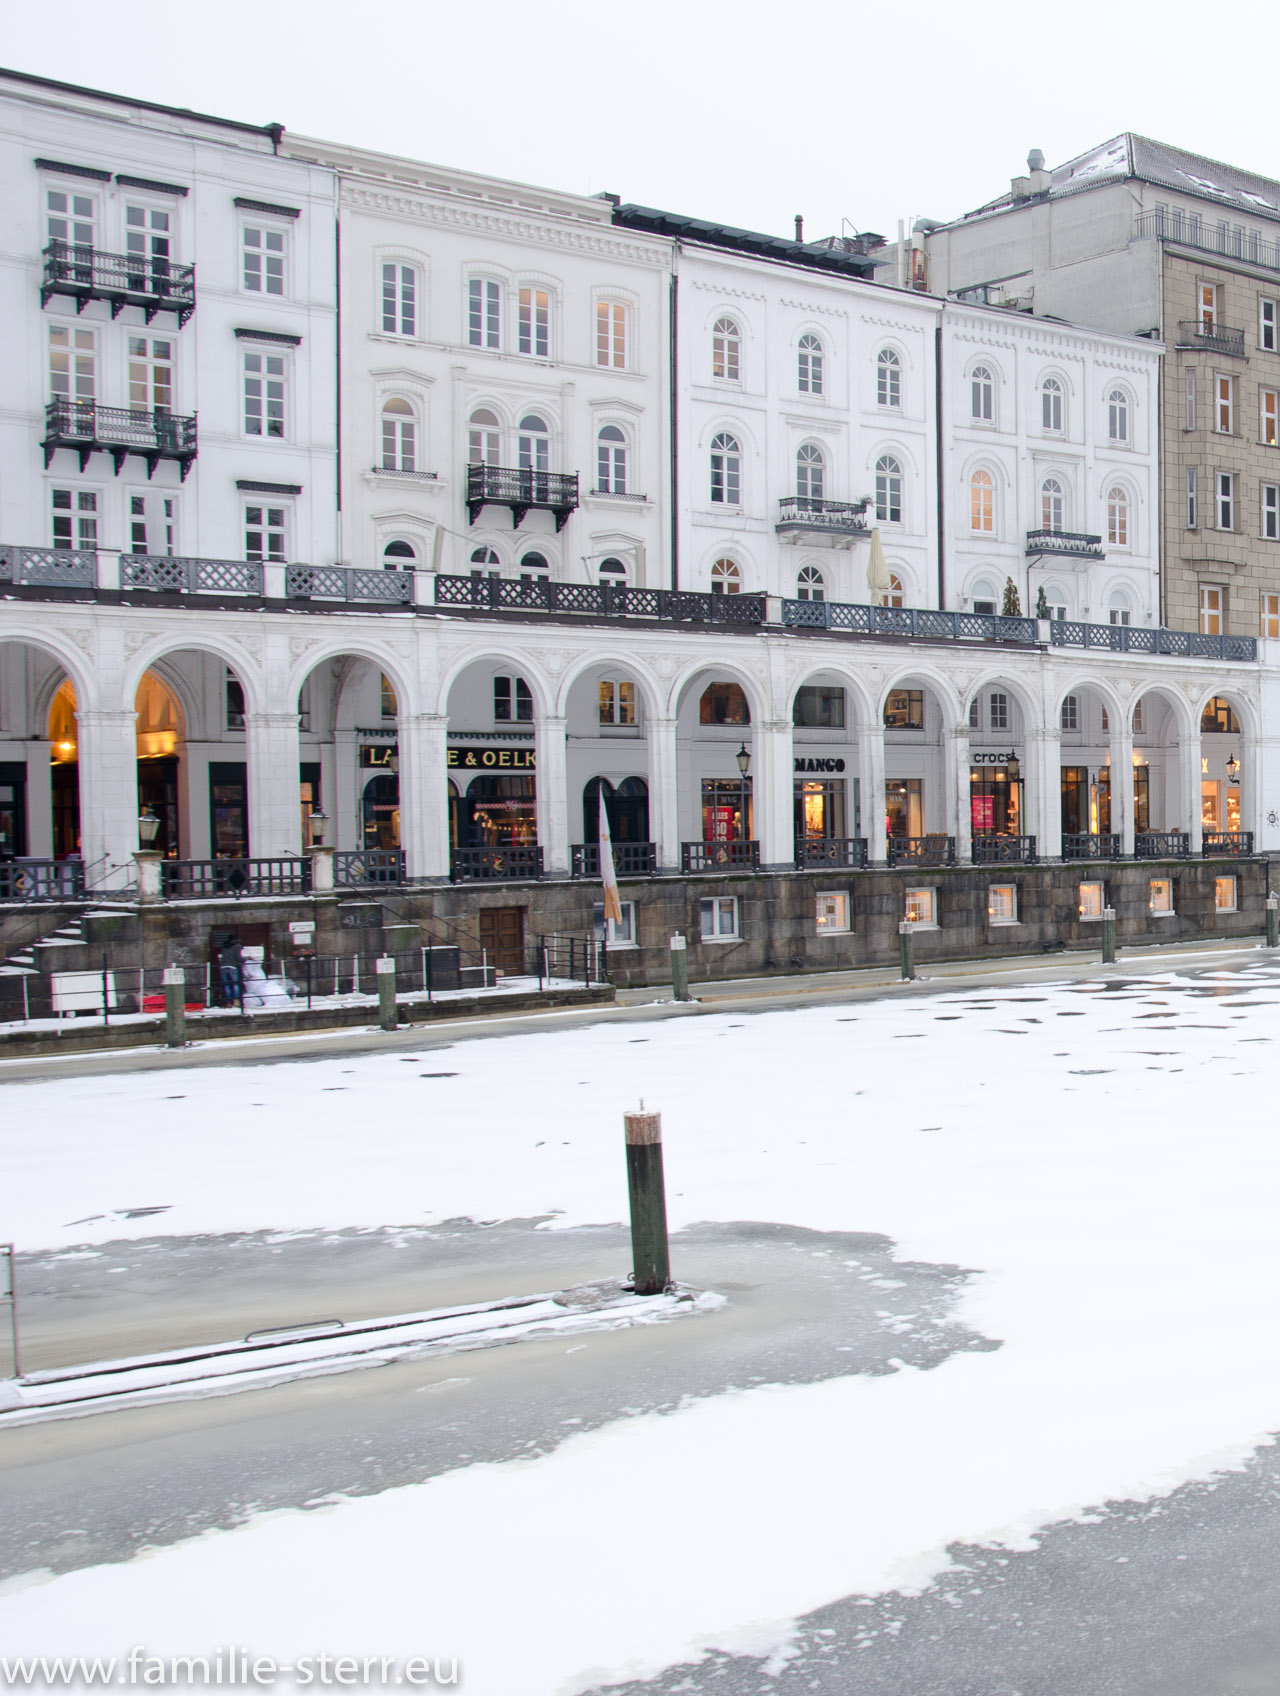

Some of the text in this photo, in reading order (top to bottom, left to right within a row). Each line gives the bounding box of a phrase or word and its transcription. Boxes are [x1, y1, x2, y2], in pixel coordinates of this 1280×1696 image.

[465, 752, 477, 766] &
[482, 751, 536, 766] OELK
[973, 752, 1011, 763] crocs
[795, 758, 845, 772] MANGO
